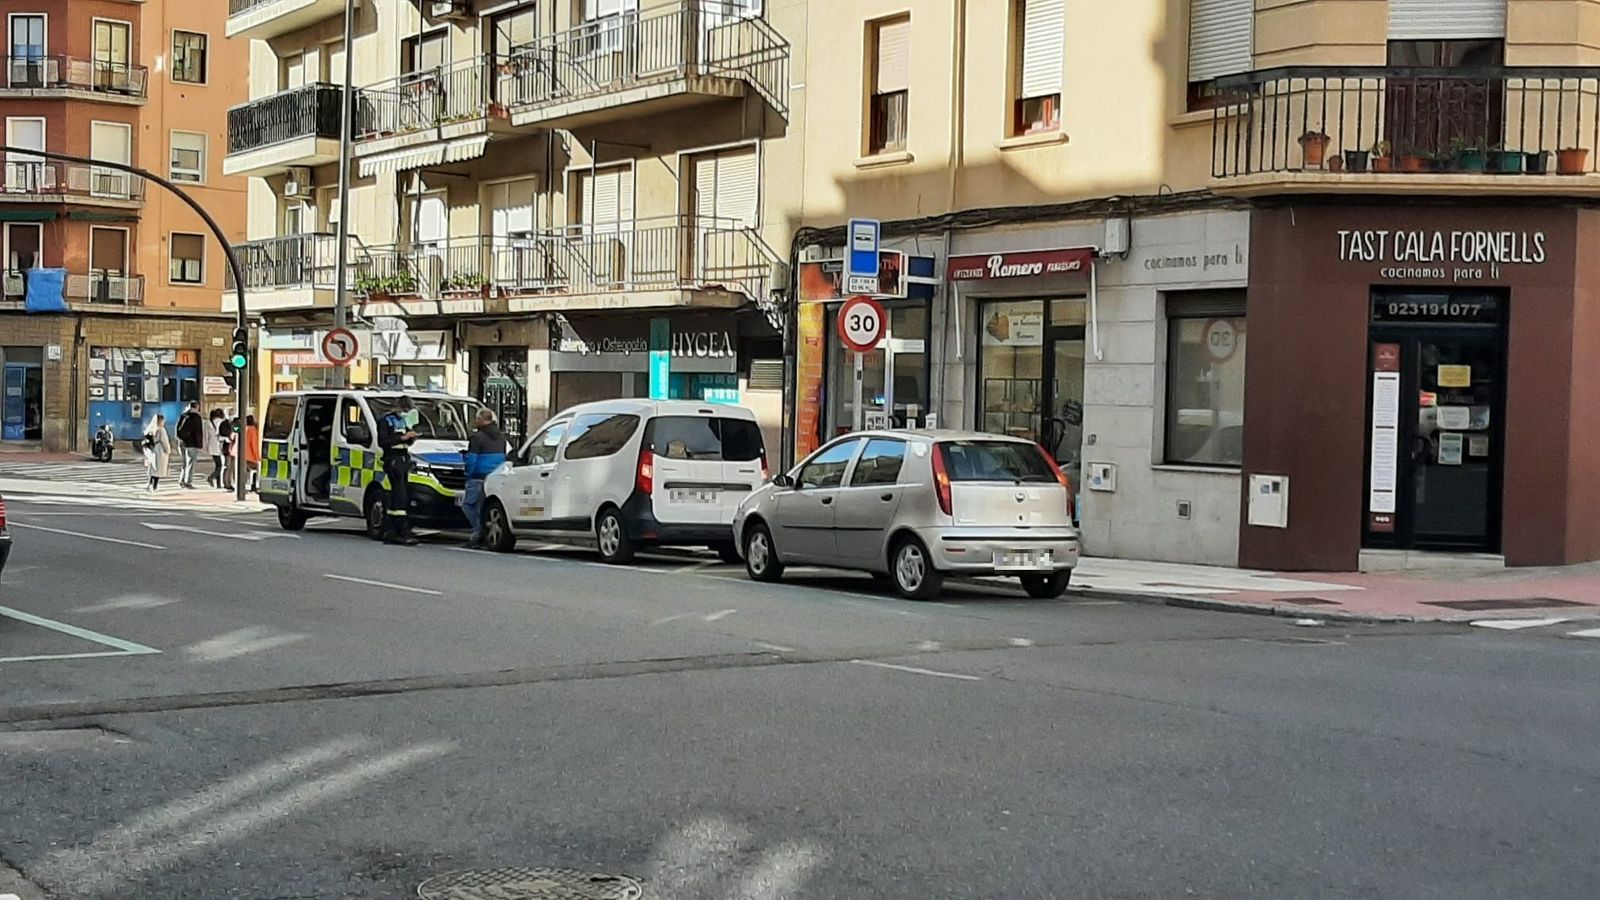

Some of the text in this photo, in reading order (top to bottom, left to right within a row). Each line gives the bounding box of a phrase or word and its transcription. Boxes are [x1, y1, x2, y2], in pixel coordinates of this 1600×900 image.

[1337, 230, 1545, 263] TAST CALA FORNELLS
[987, 255, 1043, 278] Romero
[1143, 256, 1197, 270] cocinamos
[1203, 254, 1228, 271] para
[1380, 262, 1499, 282] cocinamos para ti
[1388, 302, 1481, 316] 923191077
[850, 314, 875, 332] 30
[671, 331, 735, 358] HYGEA
